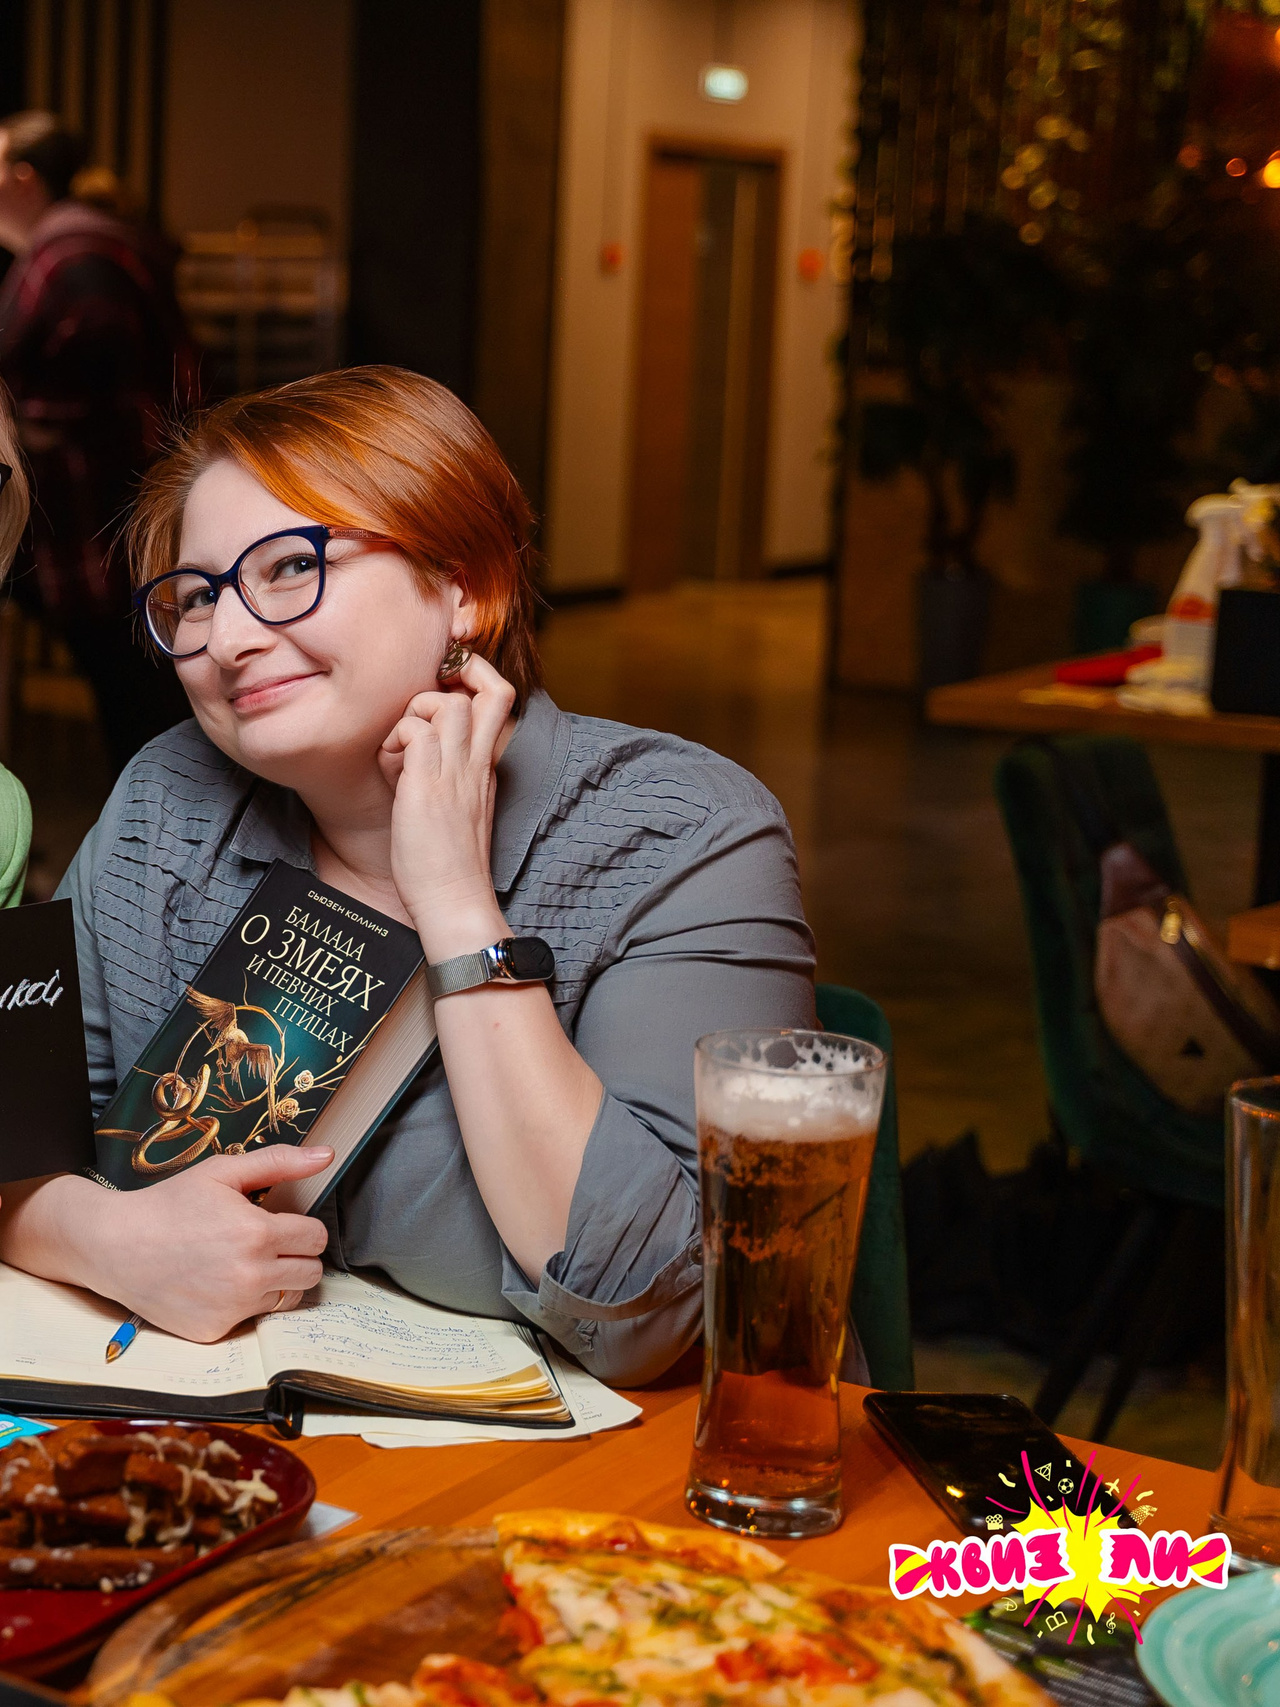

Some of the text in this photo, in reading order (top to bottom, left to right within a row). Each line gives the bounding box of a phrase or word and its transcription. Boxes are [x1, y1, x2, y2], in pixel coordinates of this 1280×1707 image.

[285, 905, 366, 962] БАЛЛАДА
[307, 890, 389, 938] СЬЮЗЕН КОЛЛИНЗ
[240, 914, 385, 1011] О ЗМЕЯХ
[246, 954, 339, 1017] И ПЕВЧИХ
[273, 996, 353, 1053] ПТИЦАХ
